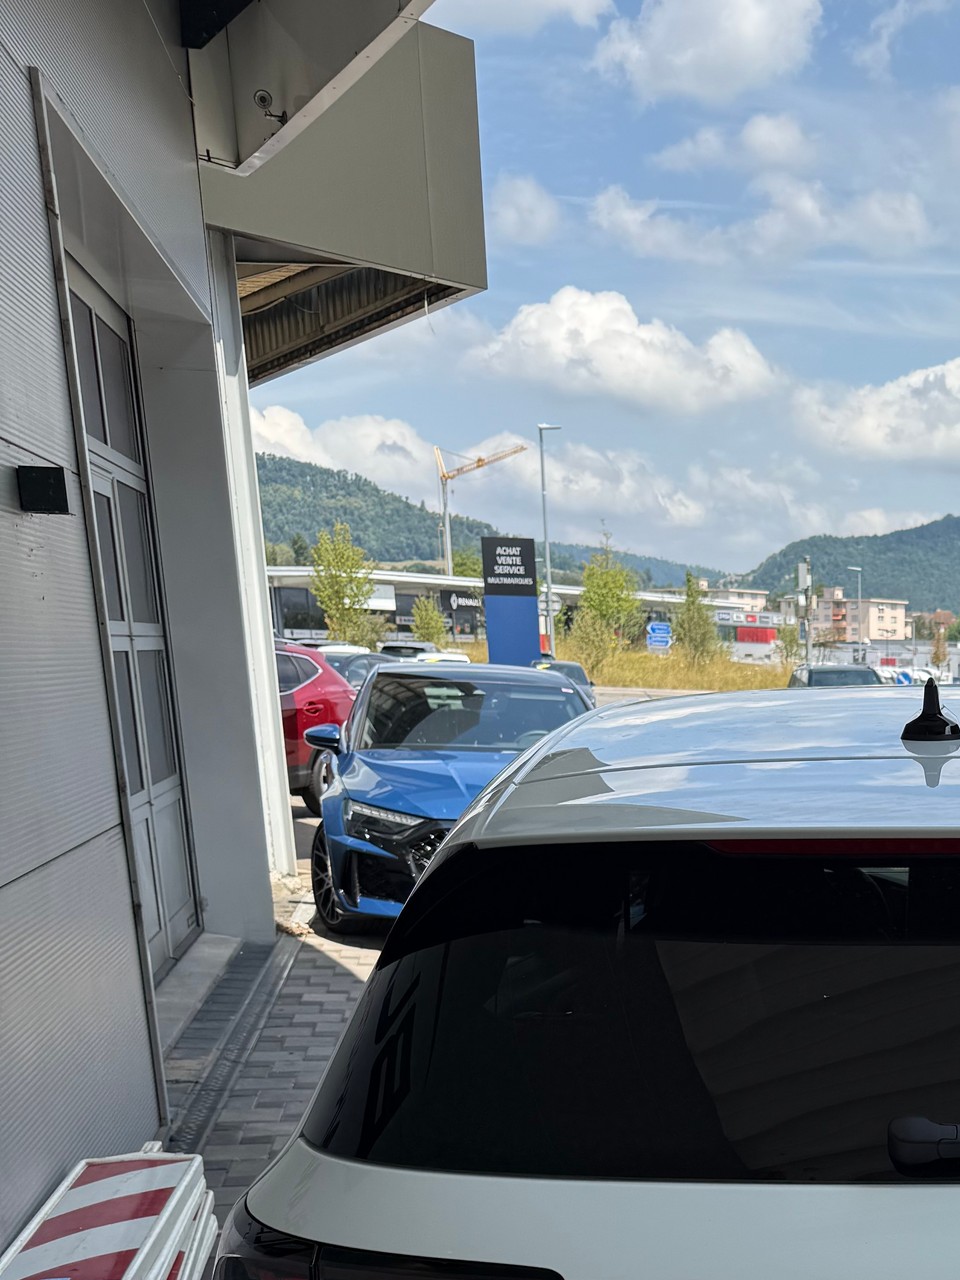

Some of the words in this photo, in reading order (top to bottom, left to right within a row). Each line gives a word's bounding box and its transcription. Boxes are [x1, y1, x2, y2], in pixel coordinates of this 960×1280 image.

[496, 546, 521, 555] ACHAT
[496, 556, 522, 565] VENTE
[493, 565, 525, 574] SERVICE
[487, 577, 533, 585] MULTIMARQUES
